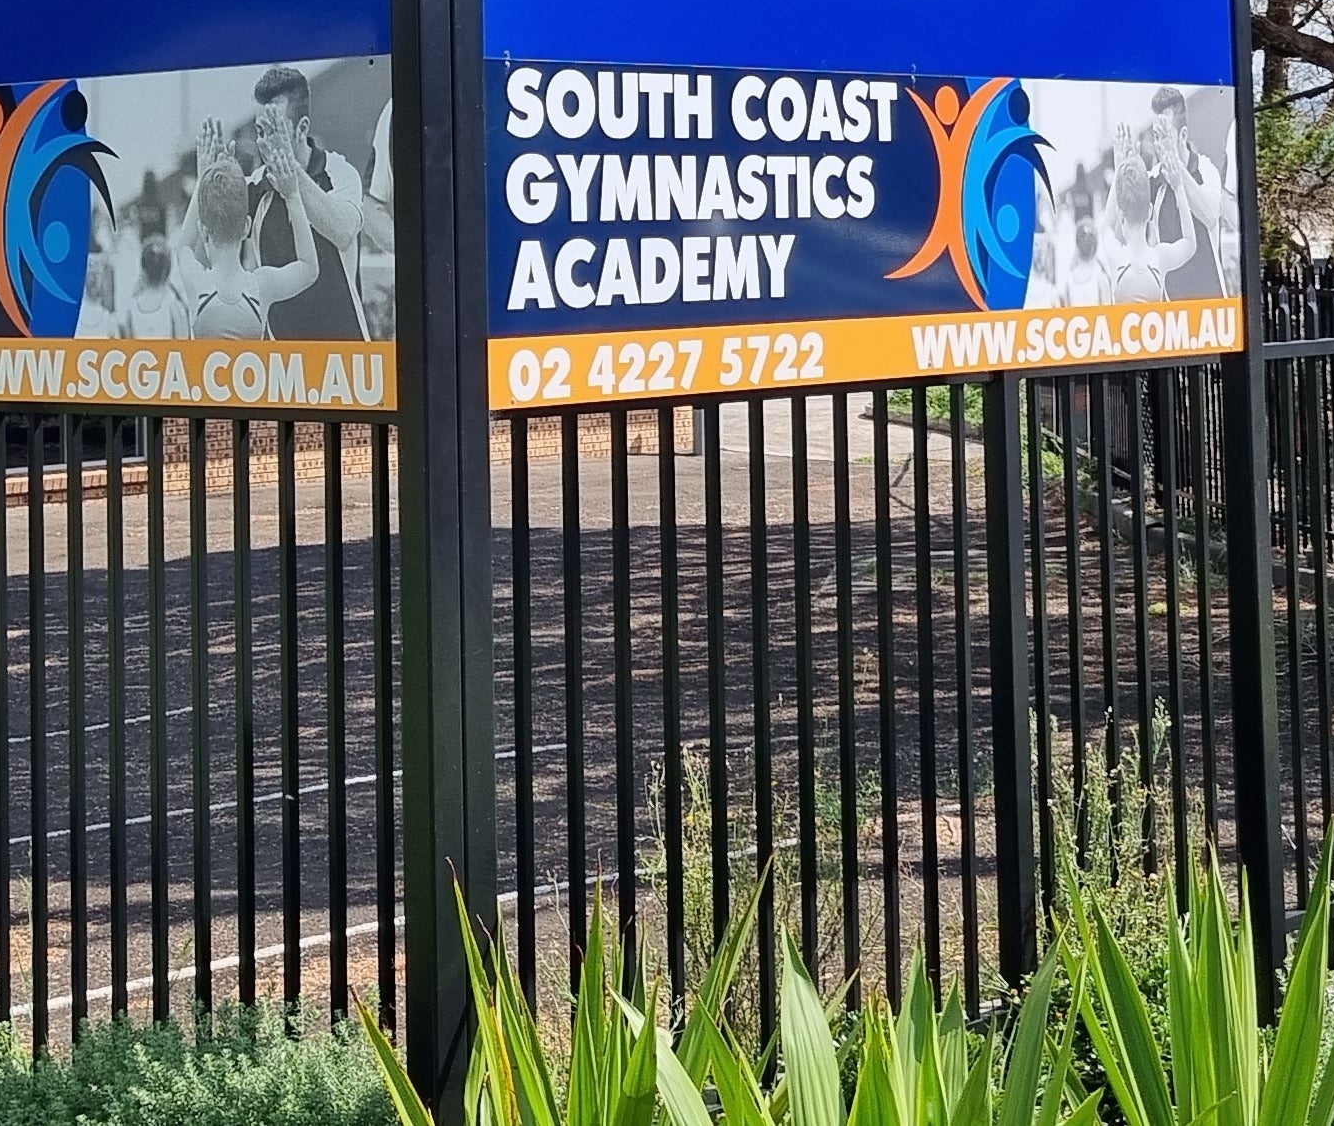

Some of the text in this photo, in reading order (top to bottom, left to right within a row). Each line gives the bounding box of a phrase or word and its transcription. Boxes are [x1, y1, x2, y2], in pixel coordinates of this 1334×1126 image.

[505, 67, 898, 143] SOUTH COAST
[505, 153, 876, 225] GYMNASTICS
[507, 234, 796, 311] ACADEMY
[508, 331, 824, 403] 02 4227 5722
[911, 307, 1236, 370] WWW.SCGA.COM.AU
